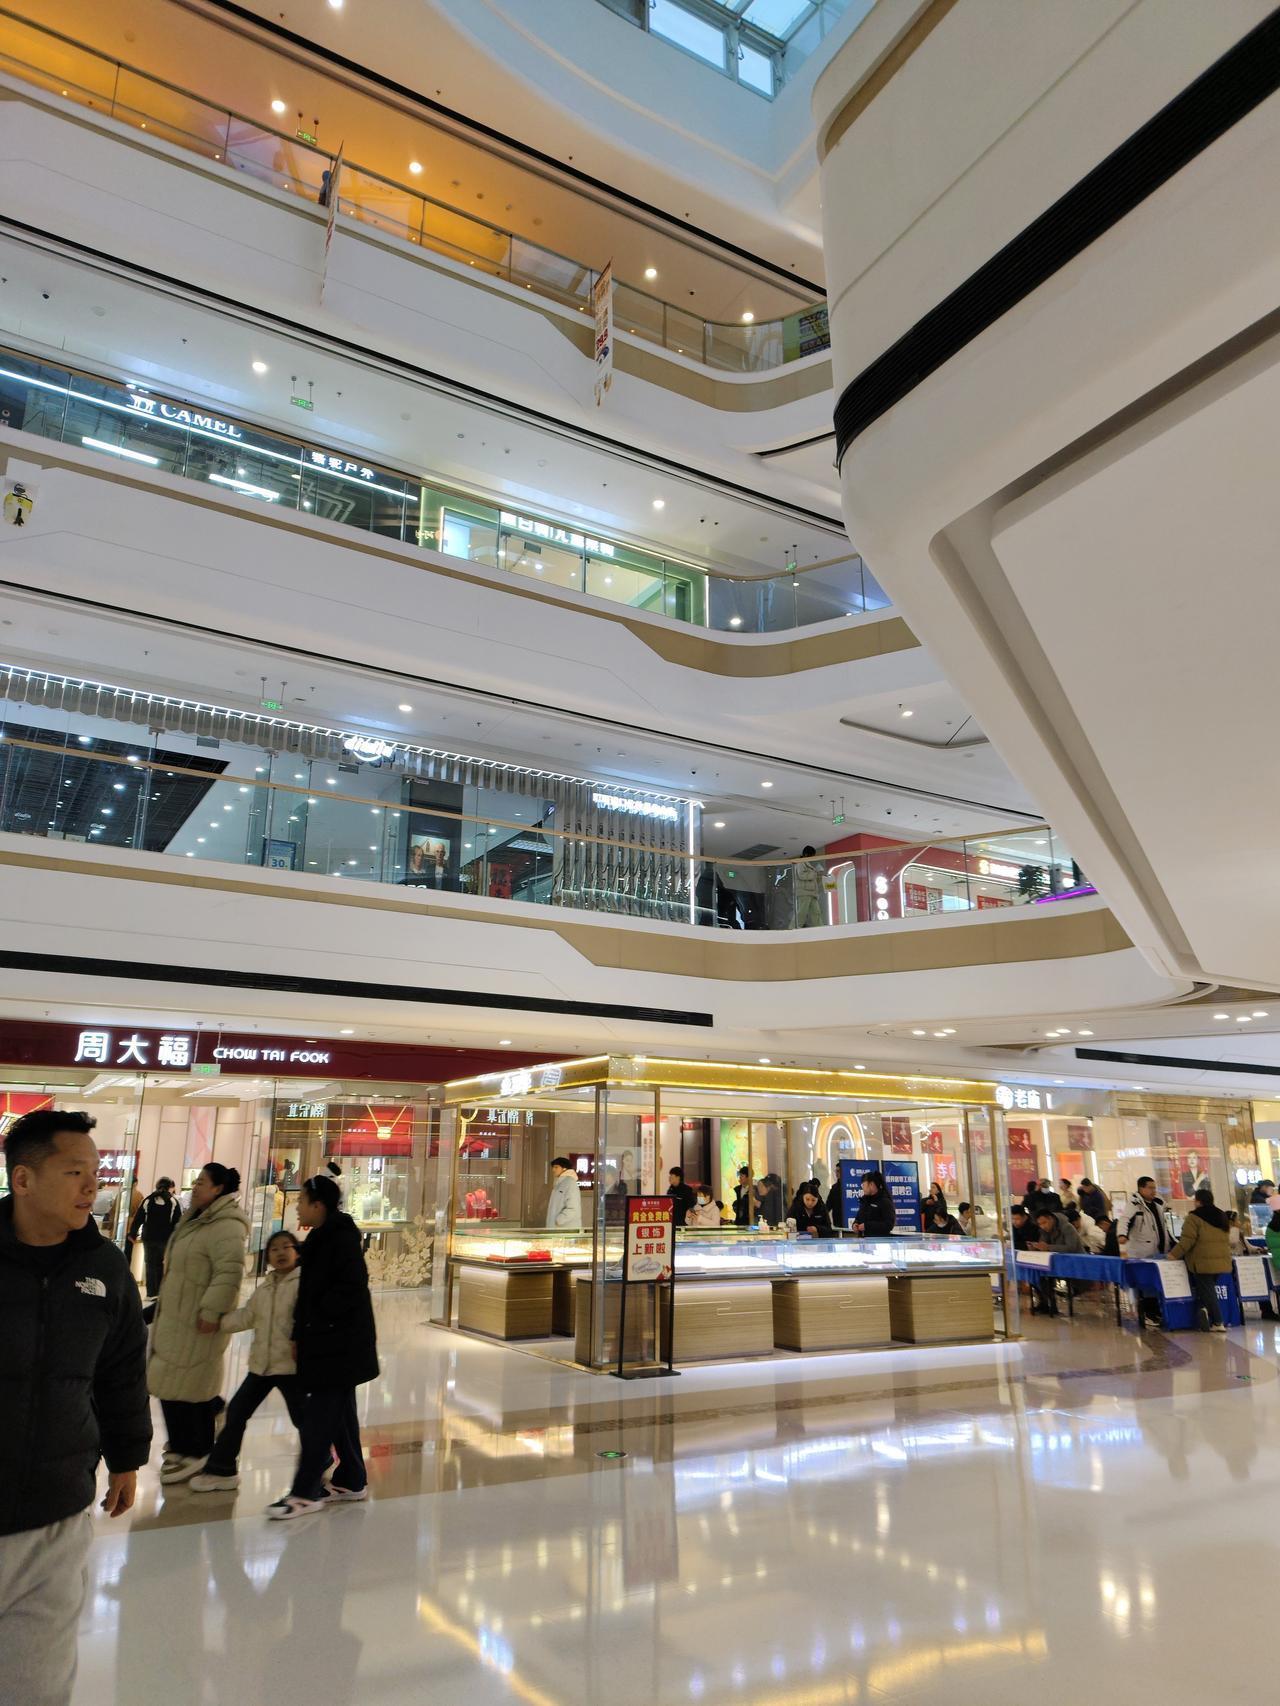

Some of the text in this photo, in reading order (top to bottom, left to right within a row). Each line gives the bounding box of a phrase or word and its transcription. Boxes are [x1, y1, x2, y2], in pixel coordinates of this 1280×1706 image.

[160, 404, 242, 438] CAMEL
[74, 1031, 190, 1066] 周大福
[213, 1047, 329, 1063] CHOW TAI FOOK
